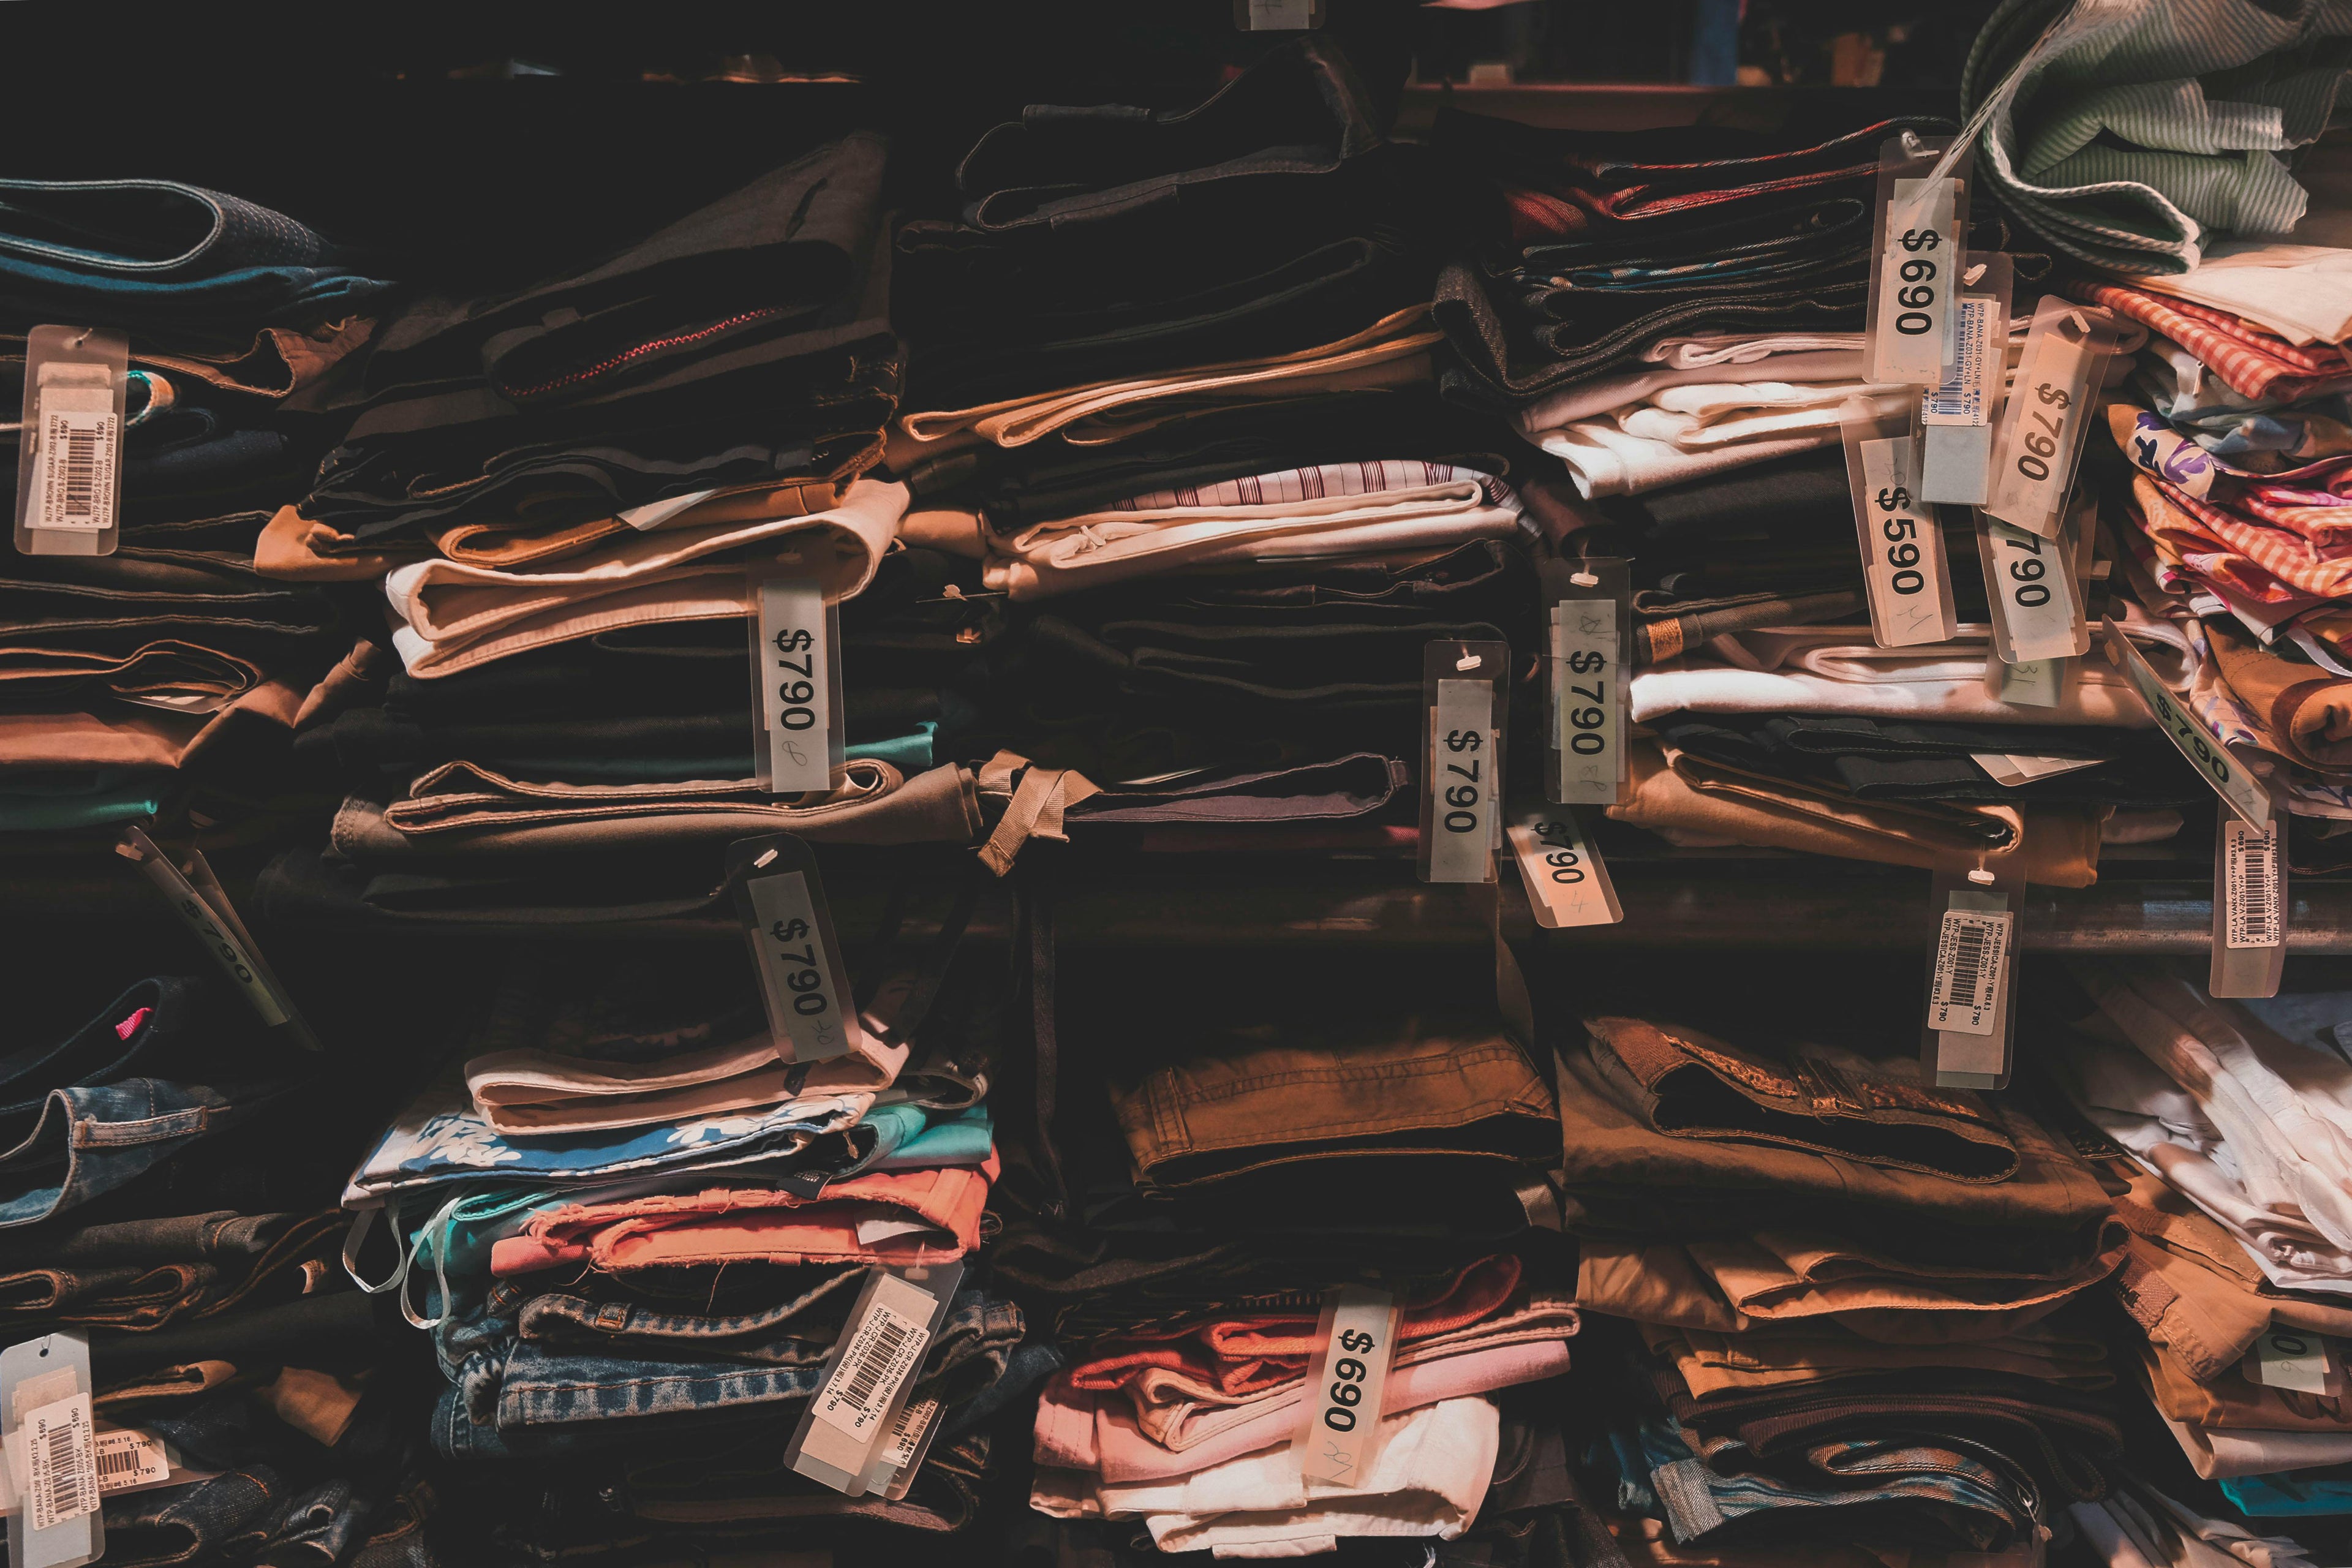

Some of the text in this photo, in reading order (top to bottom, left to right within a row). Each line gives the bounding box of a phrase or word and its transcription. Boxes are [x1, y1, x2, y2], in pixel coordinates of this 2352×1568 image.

[1894, 228, 1942, 336] $690
[1962, 392, 1971, 414] $790
[2018, 382, 2072, 482] $790
[1875, 486, 1924, 595] $590
[2000, 521, 2051, 607] 790
[772, 629, 815, 731] $790
[1566, 650, 1606, 755] $790
[2156, 693, 2229, 783] $790
[1443, 729, 1483, 833] $790
[1530, 821, 1585, 884] $790
[182, 899, 253, 984] $790
[770, 918, 827, 1016] $790
[1945, 918, 1961, 975] W7P-JESS-Z001-Y
[1980, 922, 1993, 978] W7P-JESS-Z001-Y
[1939, 1001, 1948, 1021] $790
[1972, 1005, 1981, 1025] $790
[827, 1390, 843, 1411] $790
[854, 1406, 870, 1427] $790
[1324, 1329, 1376, 1433] $690
[130, 1440, 152, 1450] $790
[134, 1467, 156, 1476] $790
[897, 1432, 911, 1451] $690
